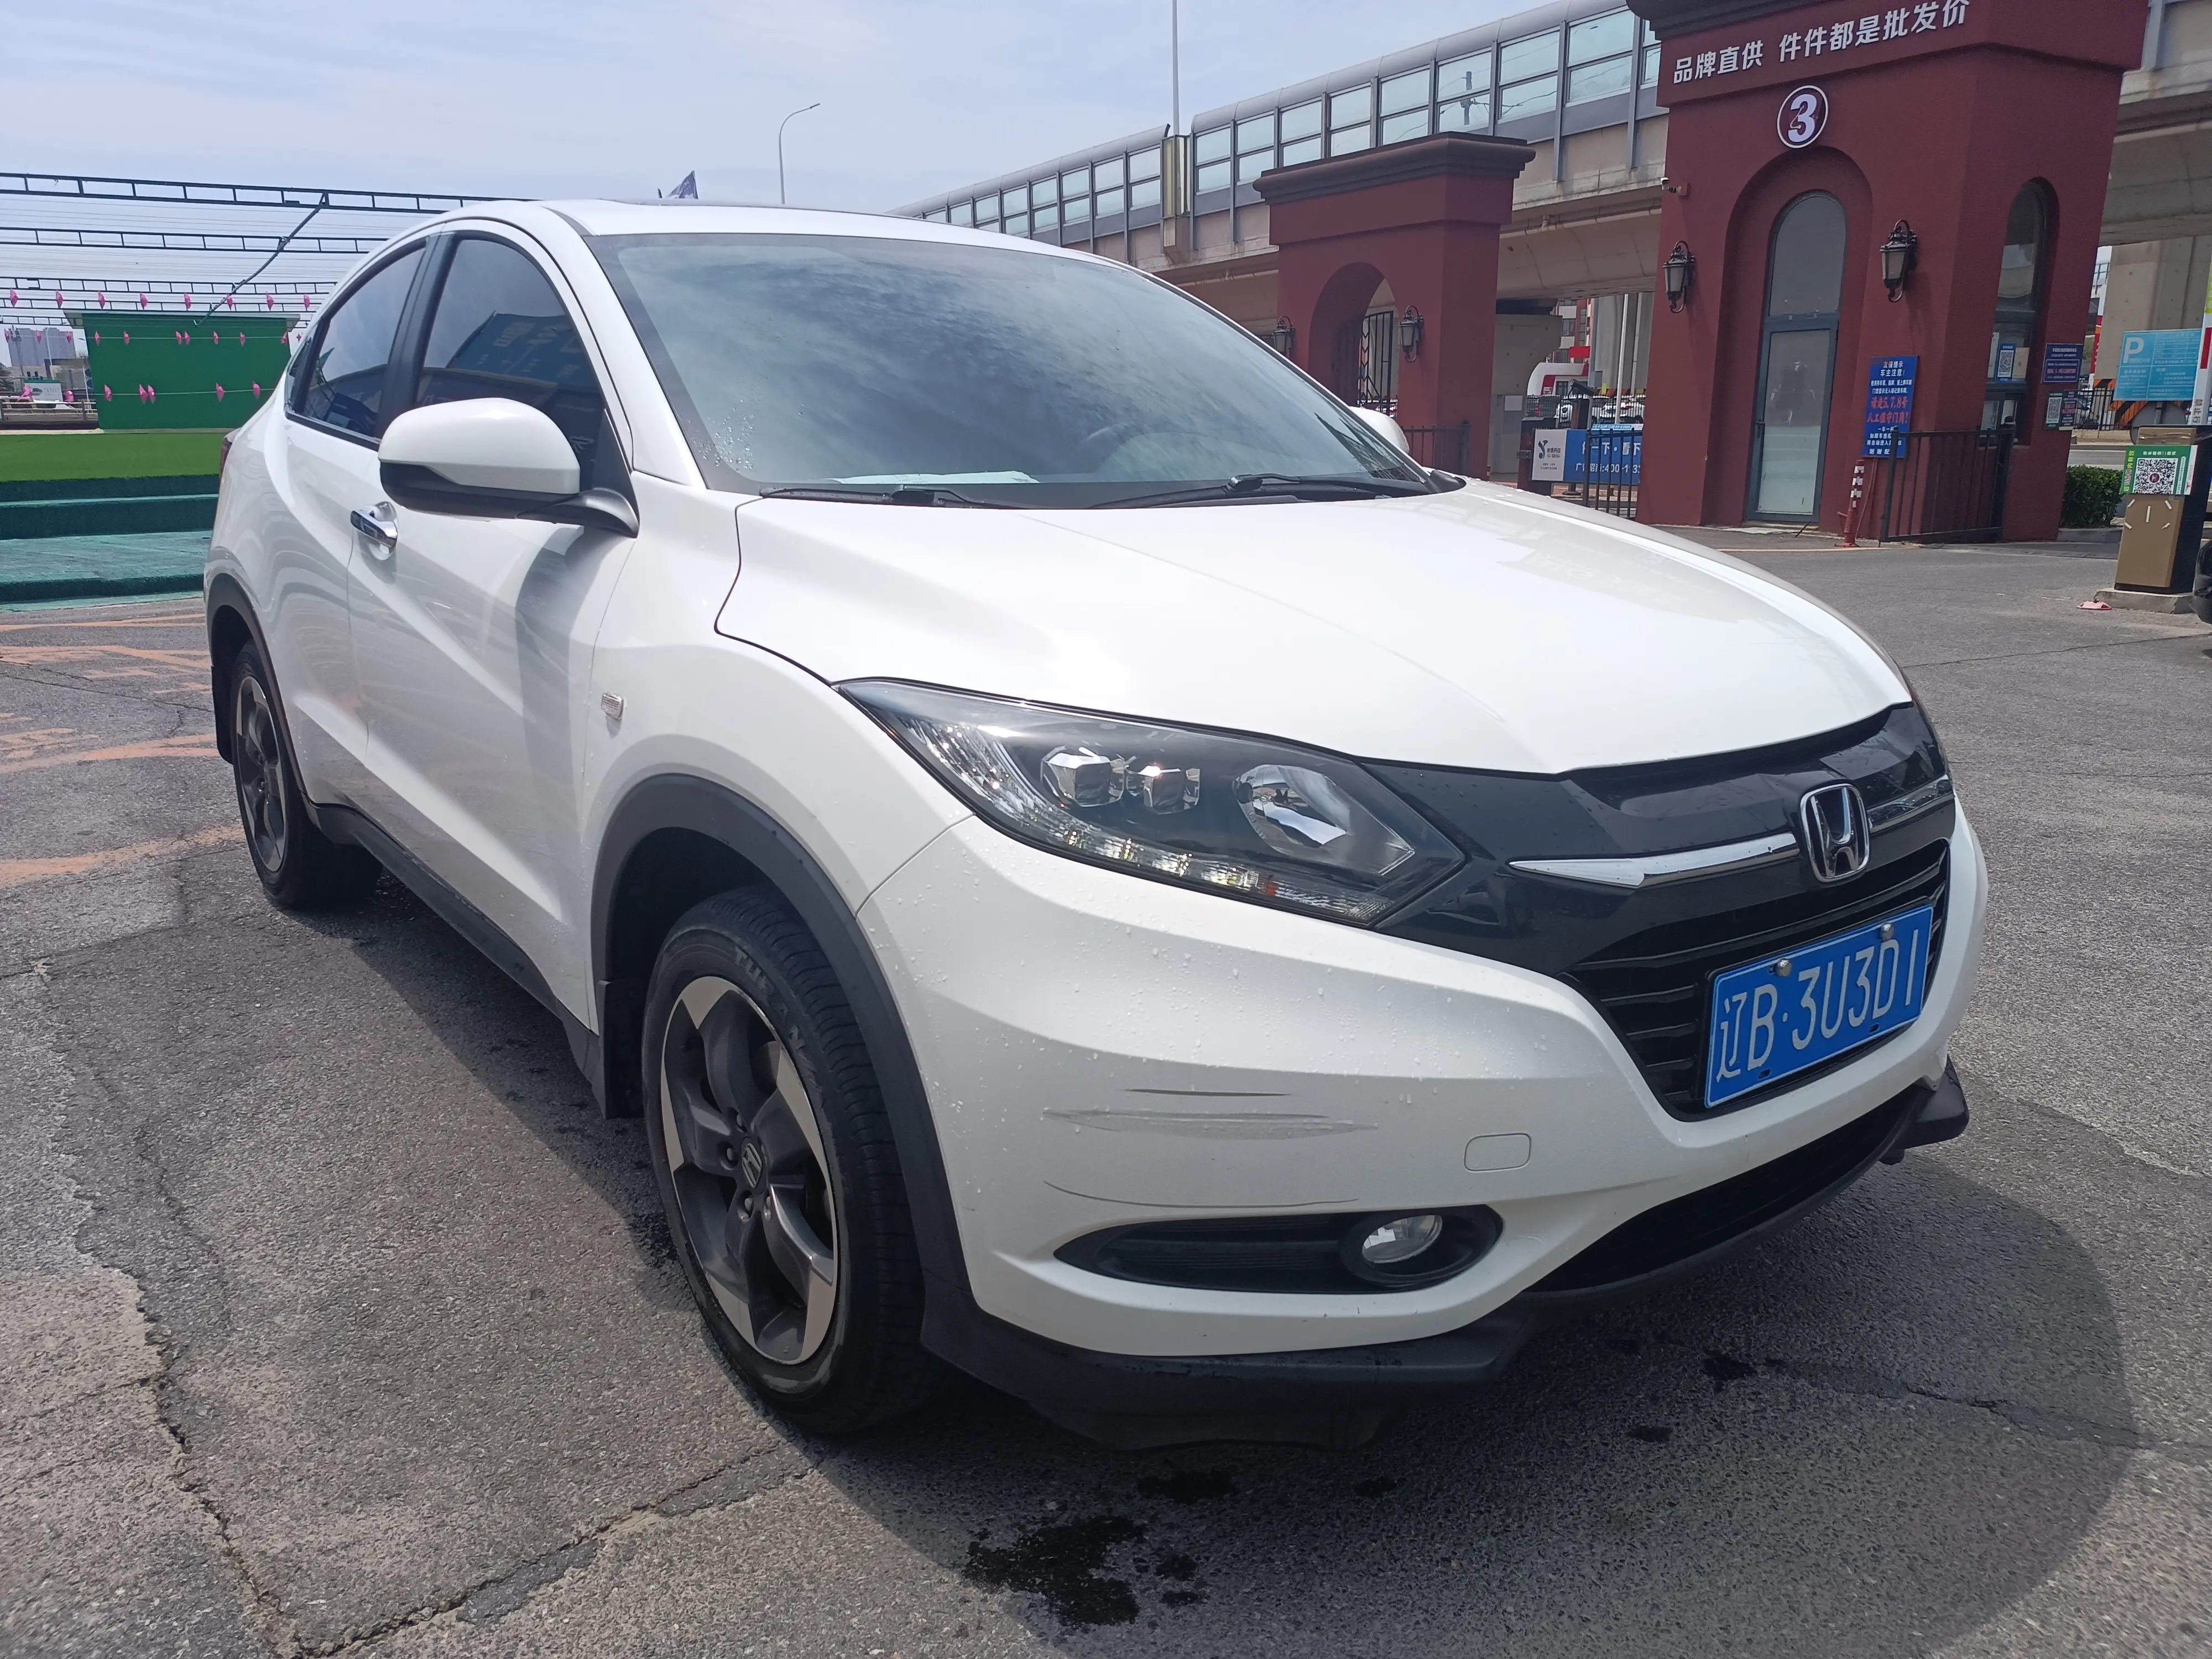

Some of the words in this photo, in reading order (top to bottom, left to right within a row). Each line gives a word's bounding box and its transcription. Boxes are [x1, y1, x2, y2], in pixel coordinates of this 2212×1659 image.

[1673, 40, 1764, 84] 品牌直供
[1779, 0, 1969, 62] 件件都是批发价
[1788, 93, 1817, 143] 3
[2122, 337, 2145, 363] P
